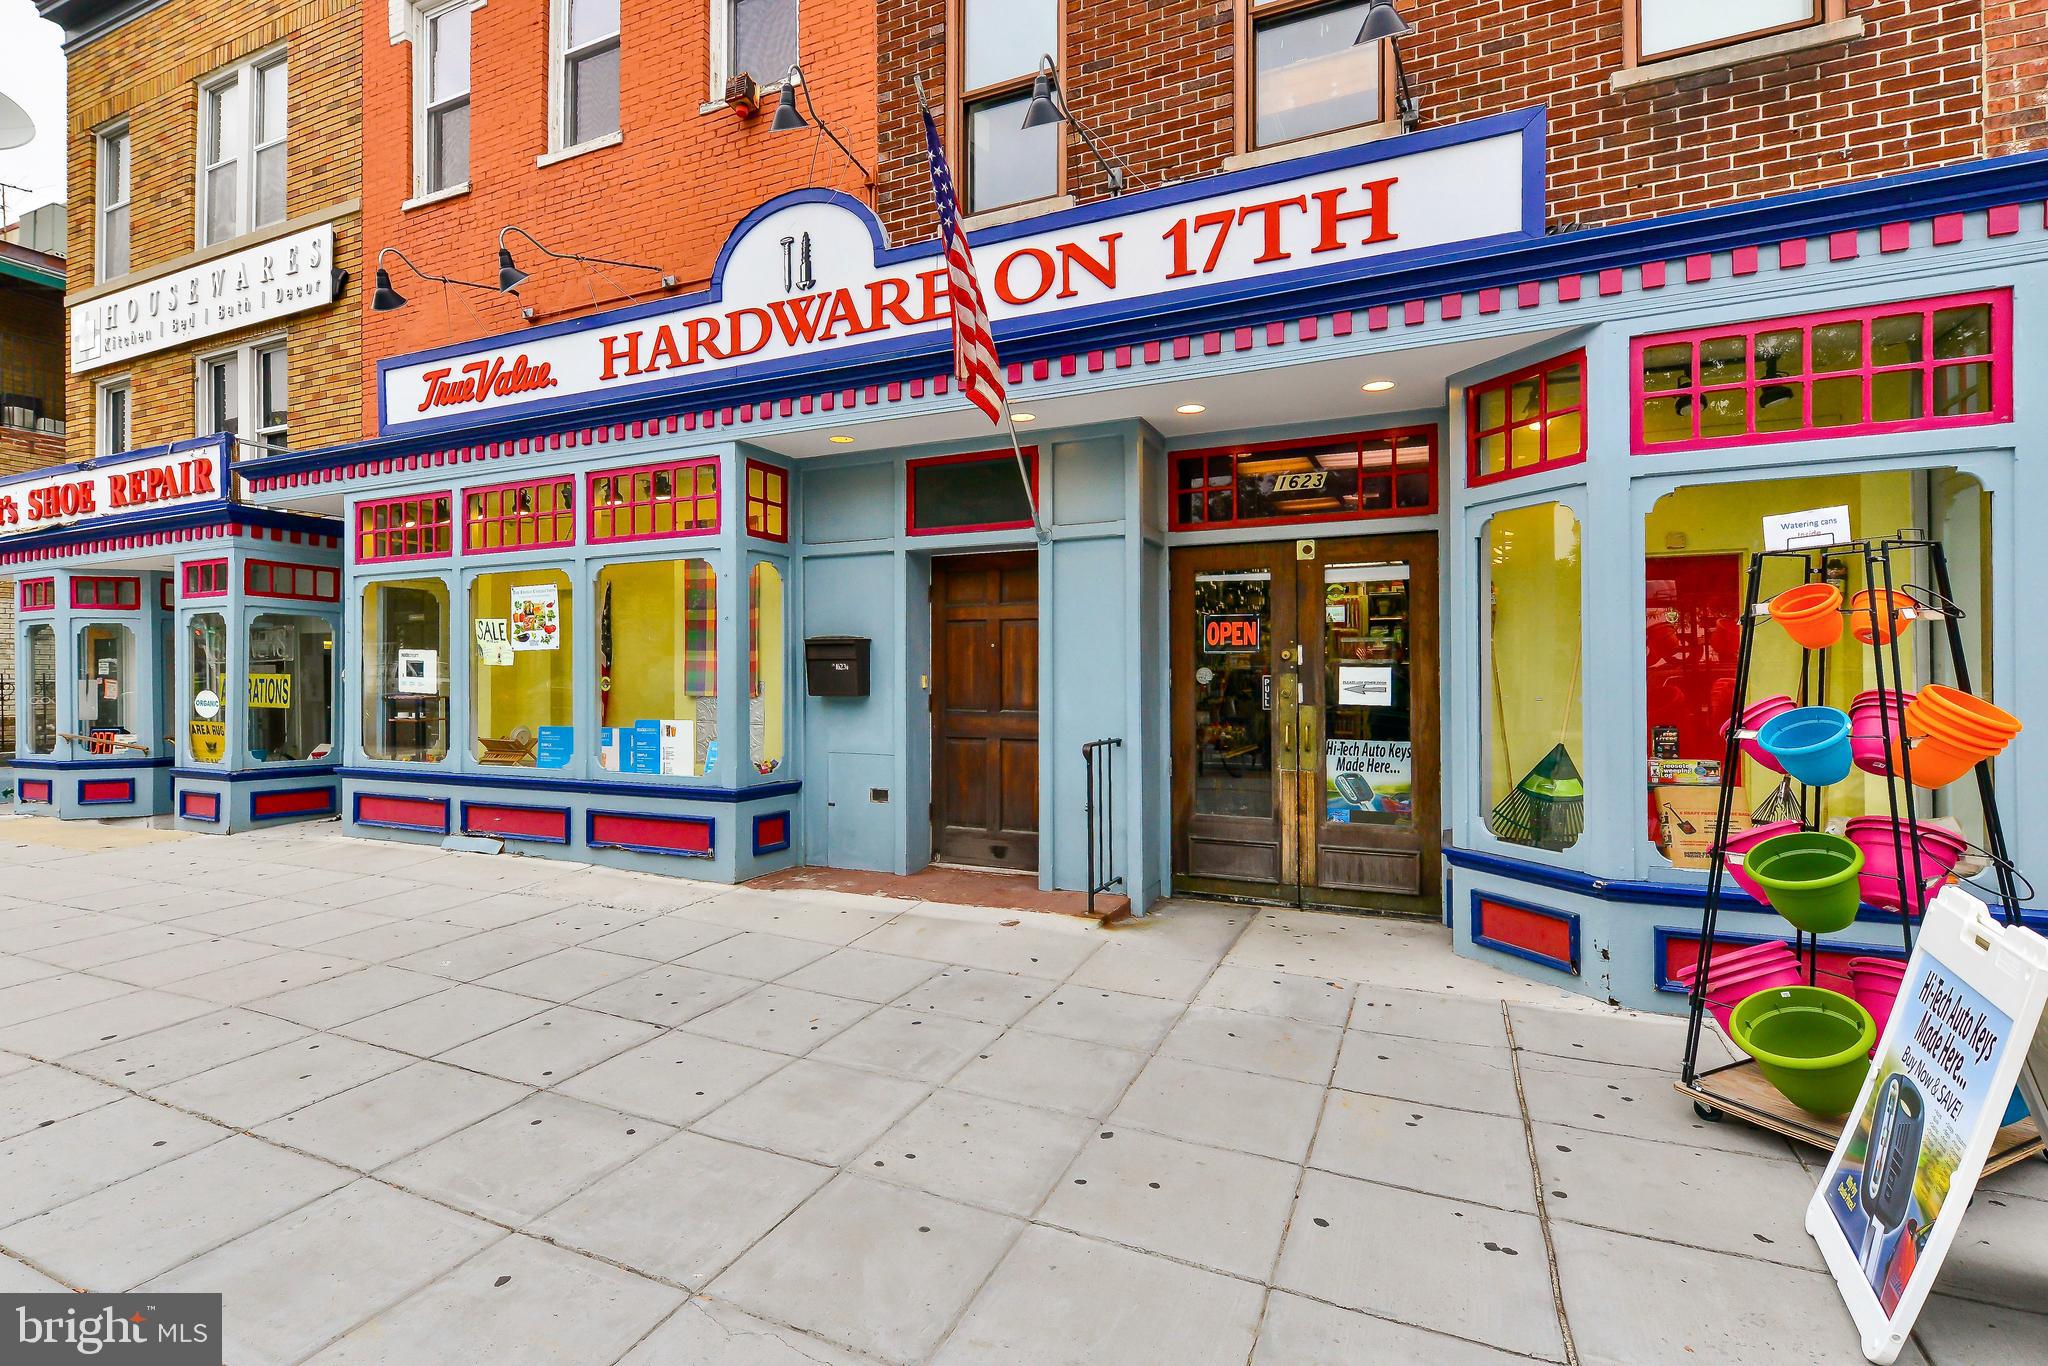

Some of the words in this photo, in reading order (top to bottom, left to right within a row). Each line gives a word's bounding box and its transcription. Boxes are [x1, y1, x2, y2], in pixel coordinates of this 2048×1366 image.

[104, 238, 322, 330] HOUSEWARES
[599, 266, 953, 381] HARDWARE
[994, 231, 1124, 306] ON
[1161, 176, 1400, 281] 17TH
[104, 329, 152, 352] Kitchen
[171, 312, 196, 333] Bed
[217, 297, 251, 320] Bath
[276, 279, 322, 303] Decor
[27, 480, 96, 521] SHOE
[107, 458, 216, 508] REPAIR
[1279, 473, 1324, 490] 1623
[1780, 519, 1819, 530] Watering
[1820, 517, 1838, 527] cans
[477, 620, 506, 641] SALE
[1206, 621, 1257, 646] OPEN
[195, 699, 219, 708] ORGANIC
[191, 724, 210, 736] AREA
[1326, 740, 1360, 757] Hi-Tech
[1361, 742, 1386, 758] Auto
[1388, 743, 1411, 762] Keys
[1336, 757, 1365, 772] Made
[1367, 758, 1400, 774] Here...
[1918, 970, 1954, 1022] Hi-Tech
[1946, 994, 1974, 1041] Auto
[1968, 1012, 1998, 1066] Keys
[1914, 1010, 1943, 1060] Made
[1937, 1033, 1967, 1090] Here...
[1901, 1045, 1917, 1075] Buy
[1914, 1059, 1934, 1090] Now
[1930, 1077, 1941, 1097] &
[1936, 1083, 1964, 1123] SAVE!
